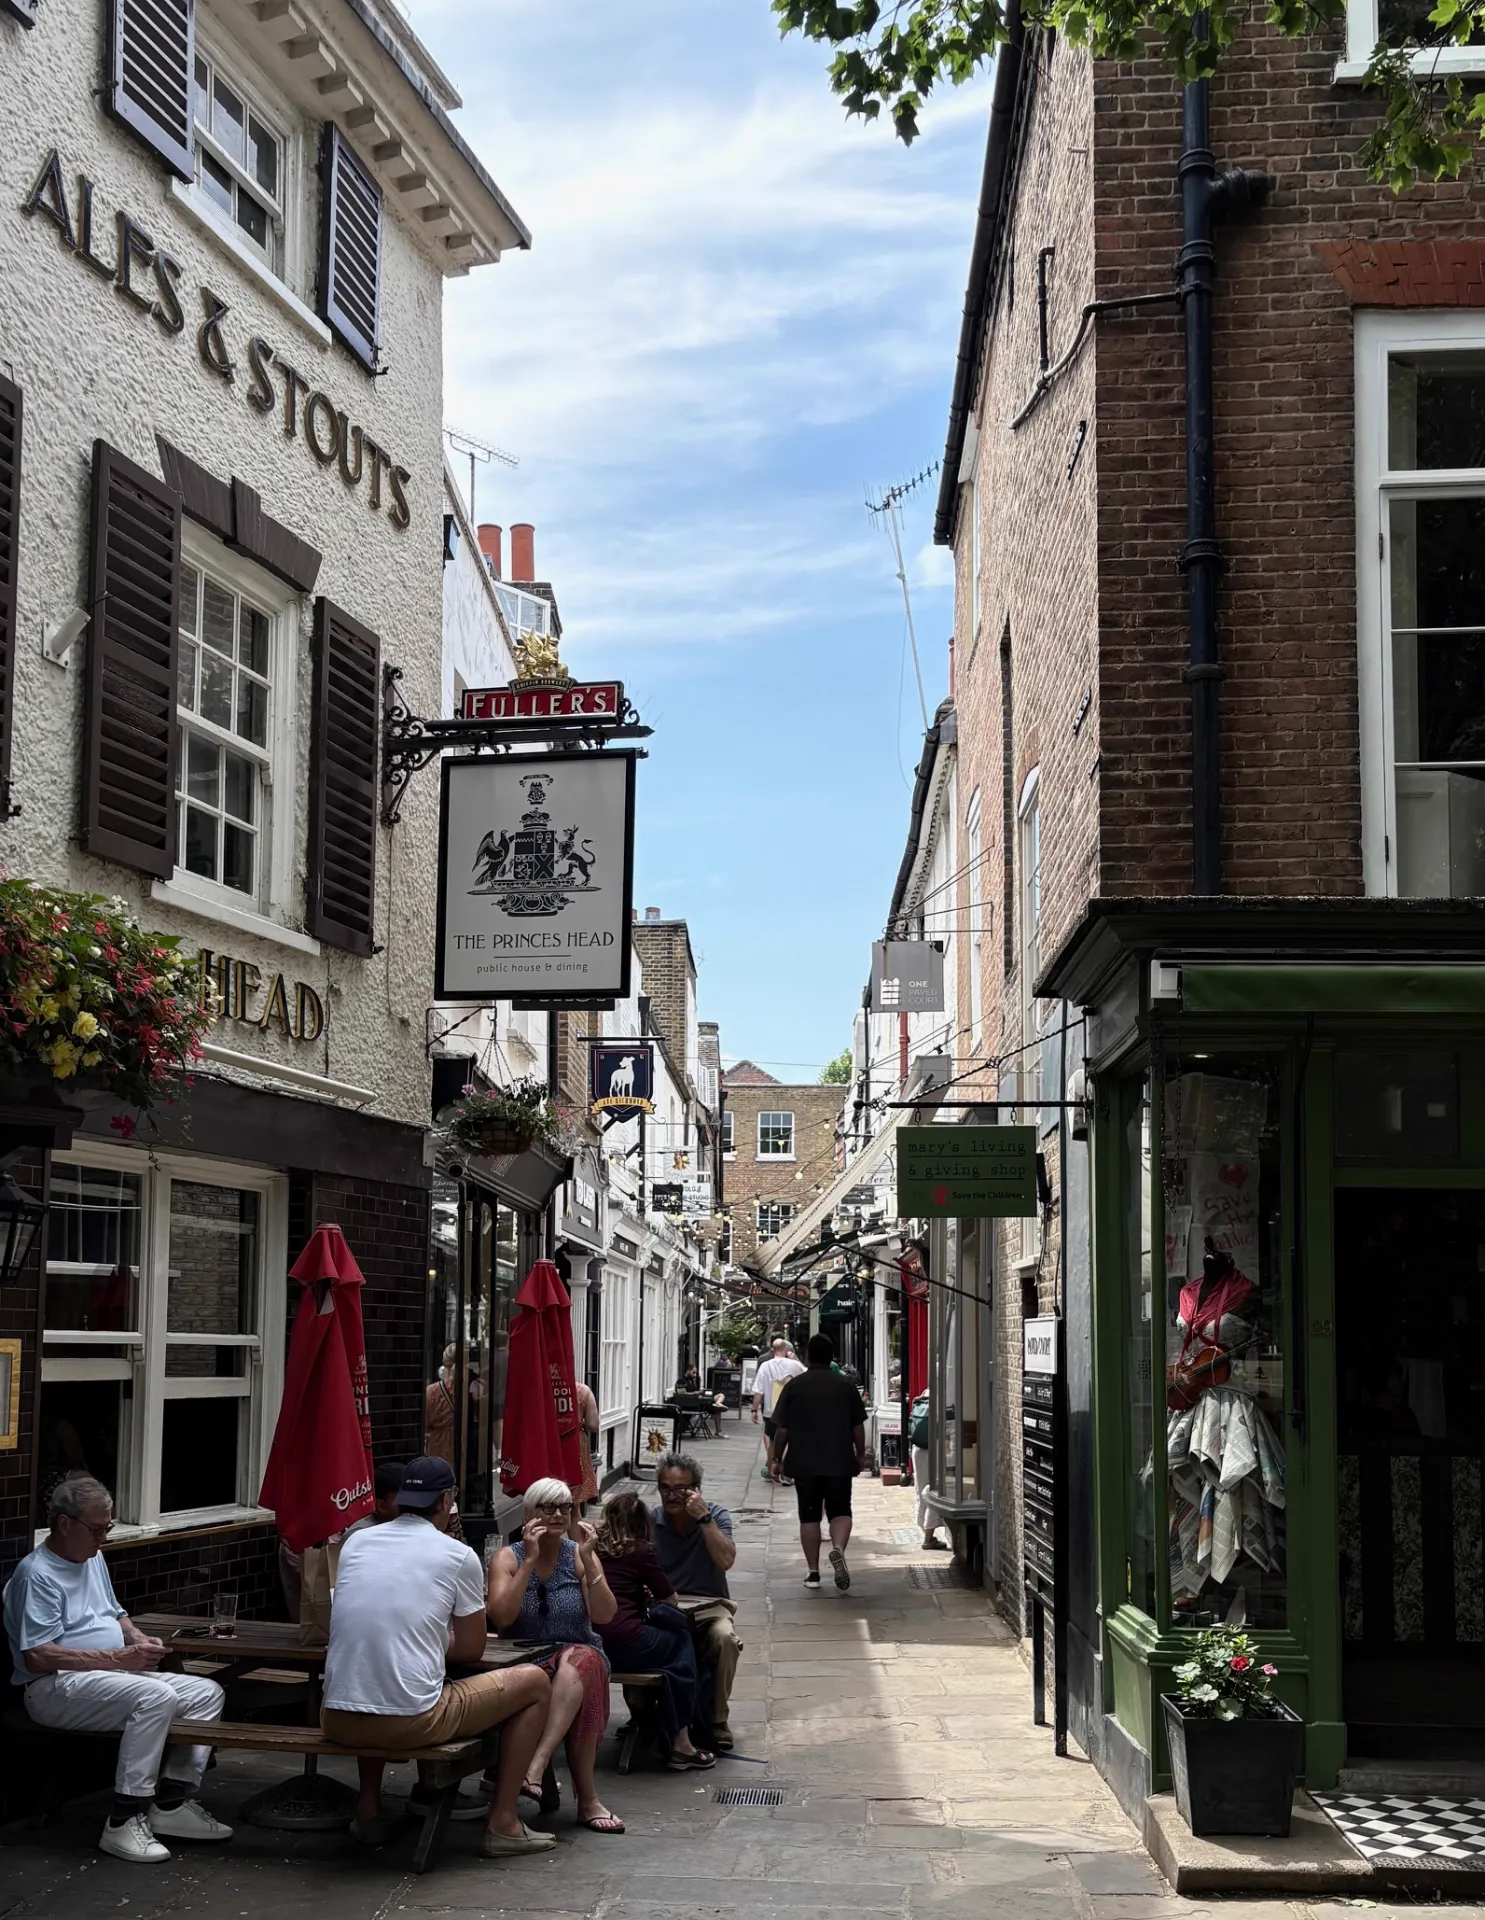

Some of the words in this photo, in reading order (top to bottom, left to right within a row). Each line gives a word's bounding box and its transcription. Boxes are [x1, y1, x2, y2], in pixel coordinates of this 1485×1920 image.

[21, 147, 184, 334] ALES
[200, 286, 236, 383] &
[246, 336, 412, 529] STOUTS
[471, 687, 607, 717] FULLER'S
[453, 934, 486, 949] THE
[493, 932, 562, 949] PRINCES
[567, 931, 614, 947] HEAD
[477, 963, 508, 974] public
[511, 963, 541, 972] house
[545, 963, 552, 972] &
[556, 961, 588, 973] dining
[908, 980, 928, 988] ONE
[200, 948, 324, 1041] HEAD
[908, 996, 938, 1004] COURT
[908, 1140, 960, 1154] mary's
[970, 1140, 1026, 1155] living
[908, 1164, 917, 1175] &
[925, 1163, 980, 1178] giving
[990, 1163, 1026, 1177] shop
[951, 1191, 971, 1199] Save
[973, 1191, 986, 1199] the
